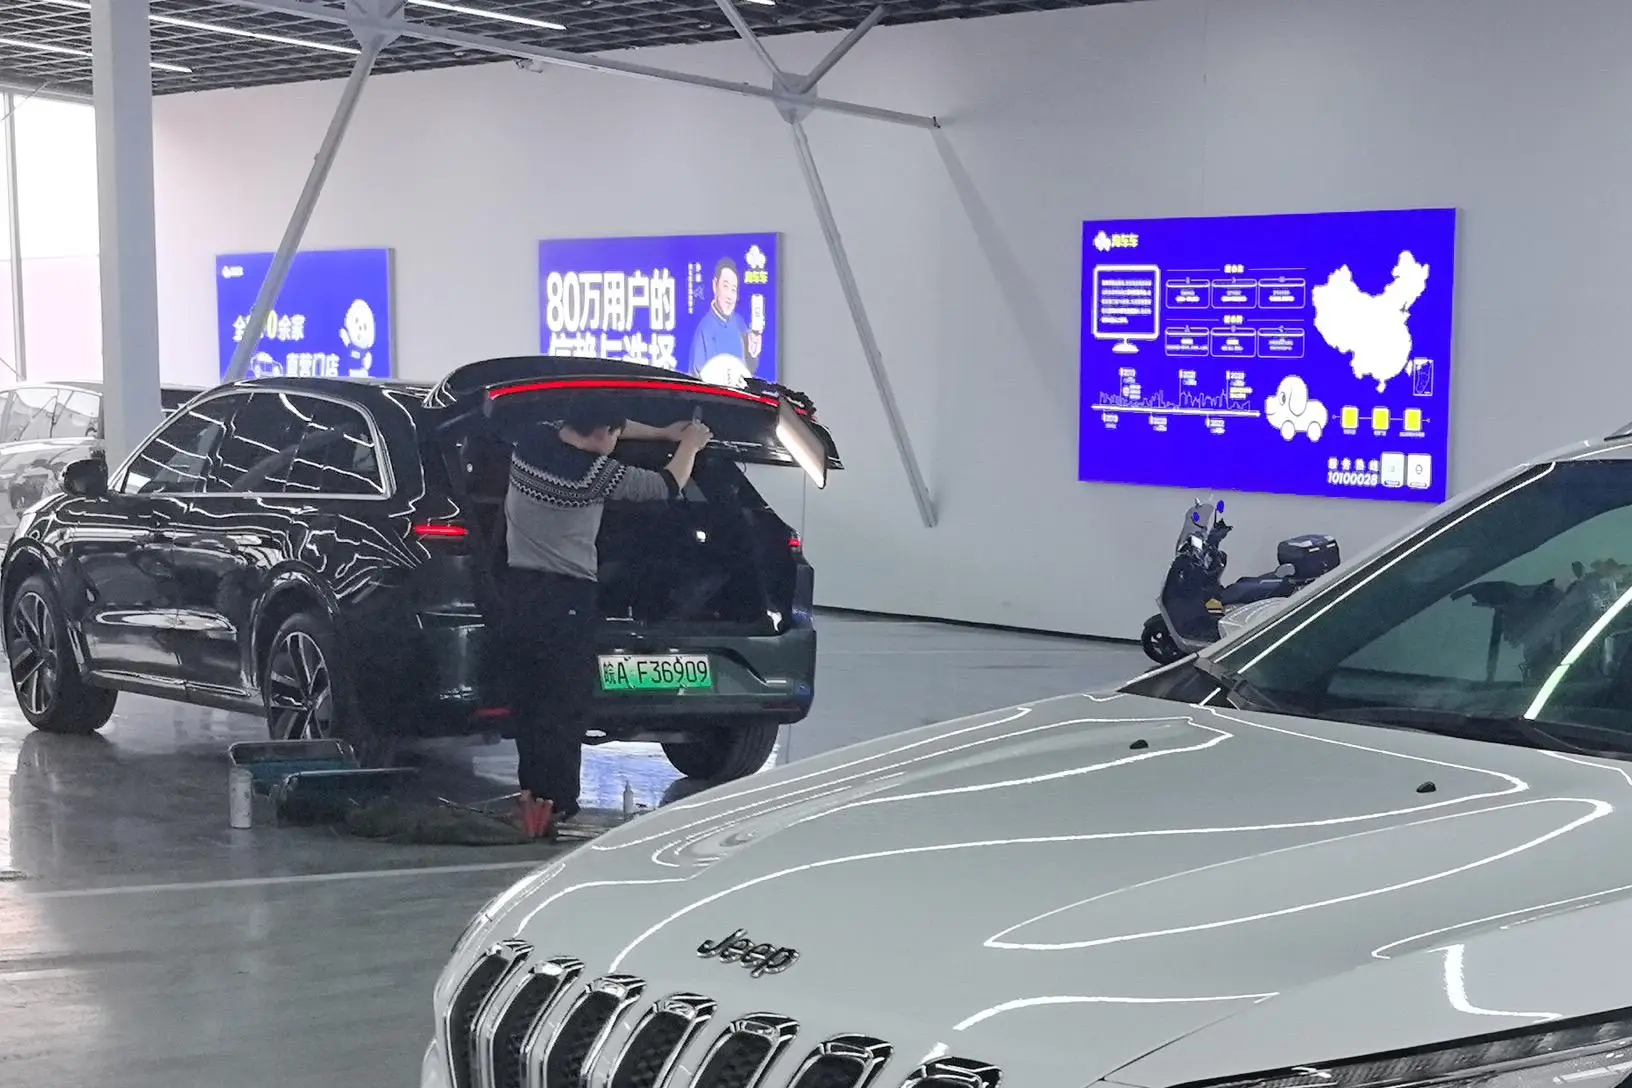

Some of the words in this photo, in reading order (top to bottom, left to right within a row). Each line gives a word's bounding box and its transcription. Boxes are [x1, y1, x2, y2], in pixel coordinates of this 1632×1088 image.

[546, 267, 676, 332] 80万用户的
[1327, 470, 1379, 486] 10100028
[637, 660, 708, 683] F36909
[696, 928, 801, 978] Jeep
